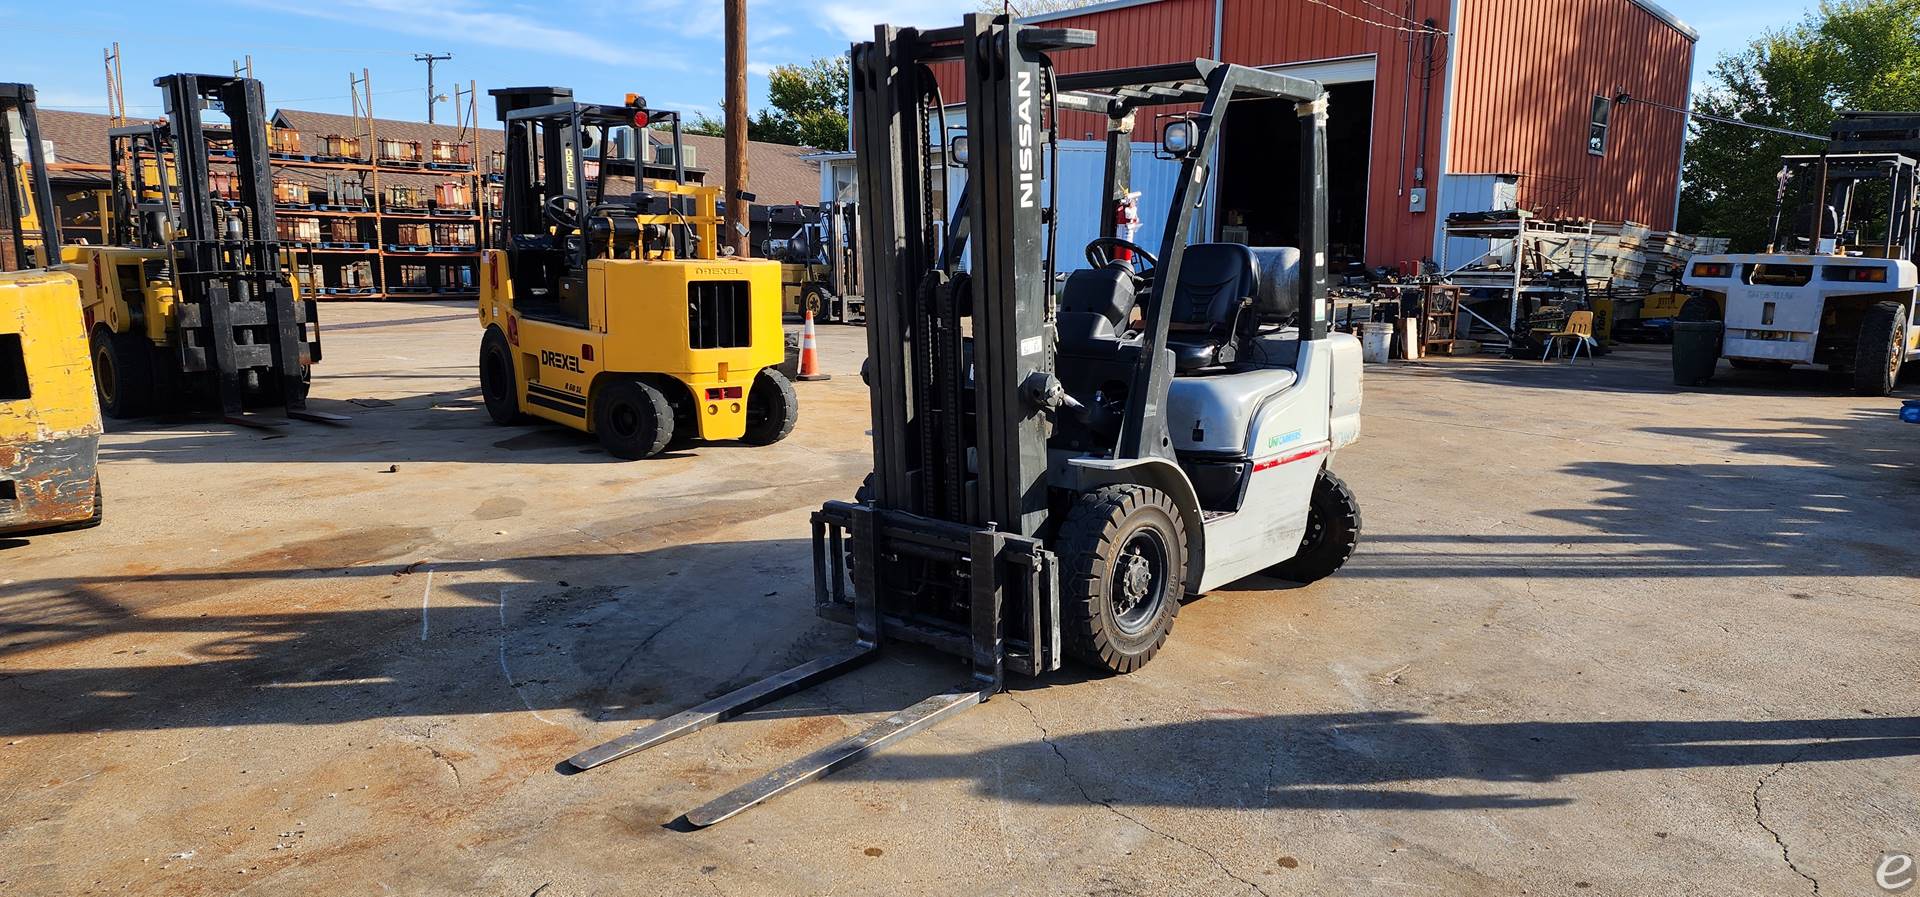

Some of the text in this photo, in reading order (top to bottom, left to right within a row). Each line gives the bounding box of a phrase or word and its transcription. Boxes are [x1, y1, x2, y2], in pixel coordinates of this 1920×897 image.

[1018, 71, 1034, 208] NISSAN
[565, 148, 575, 190] DREXEL
[541, 350, 585, 374] DREXEL
